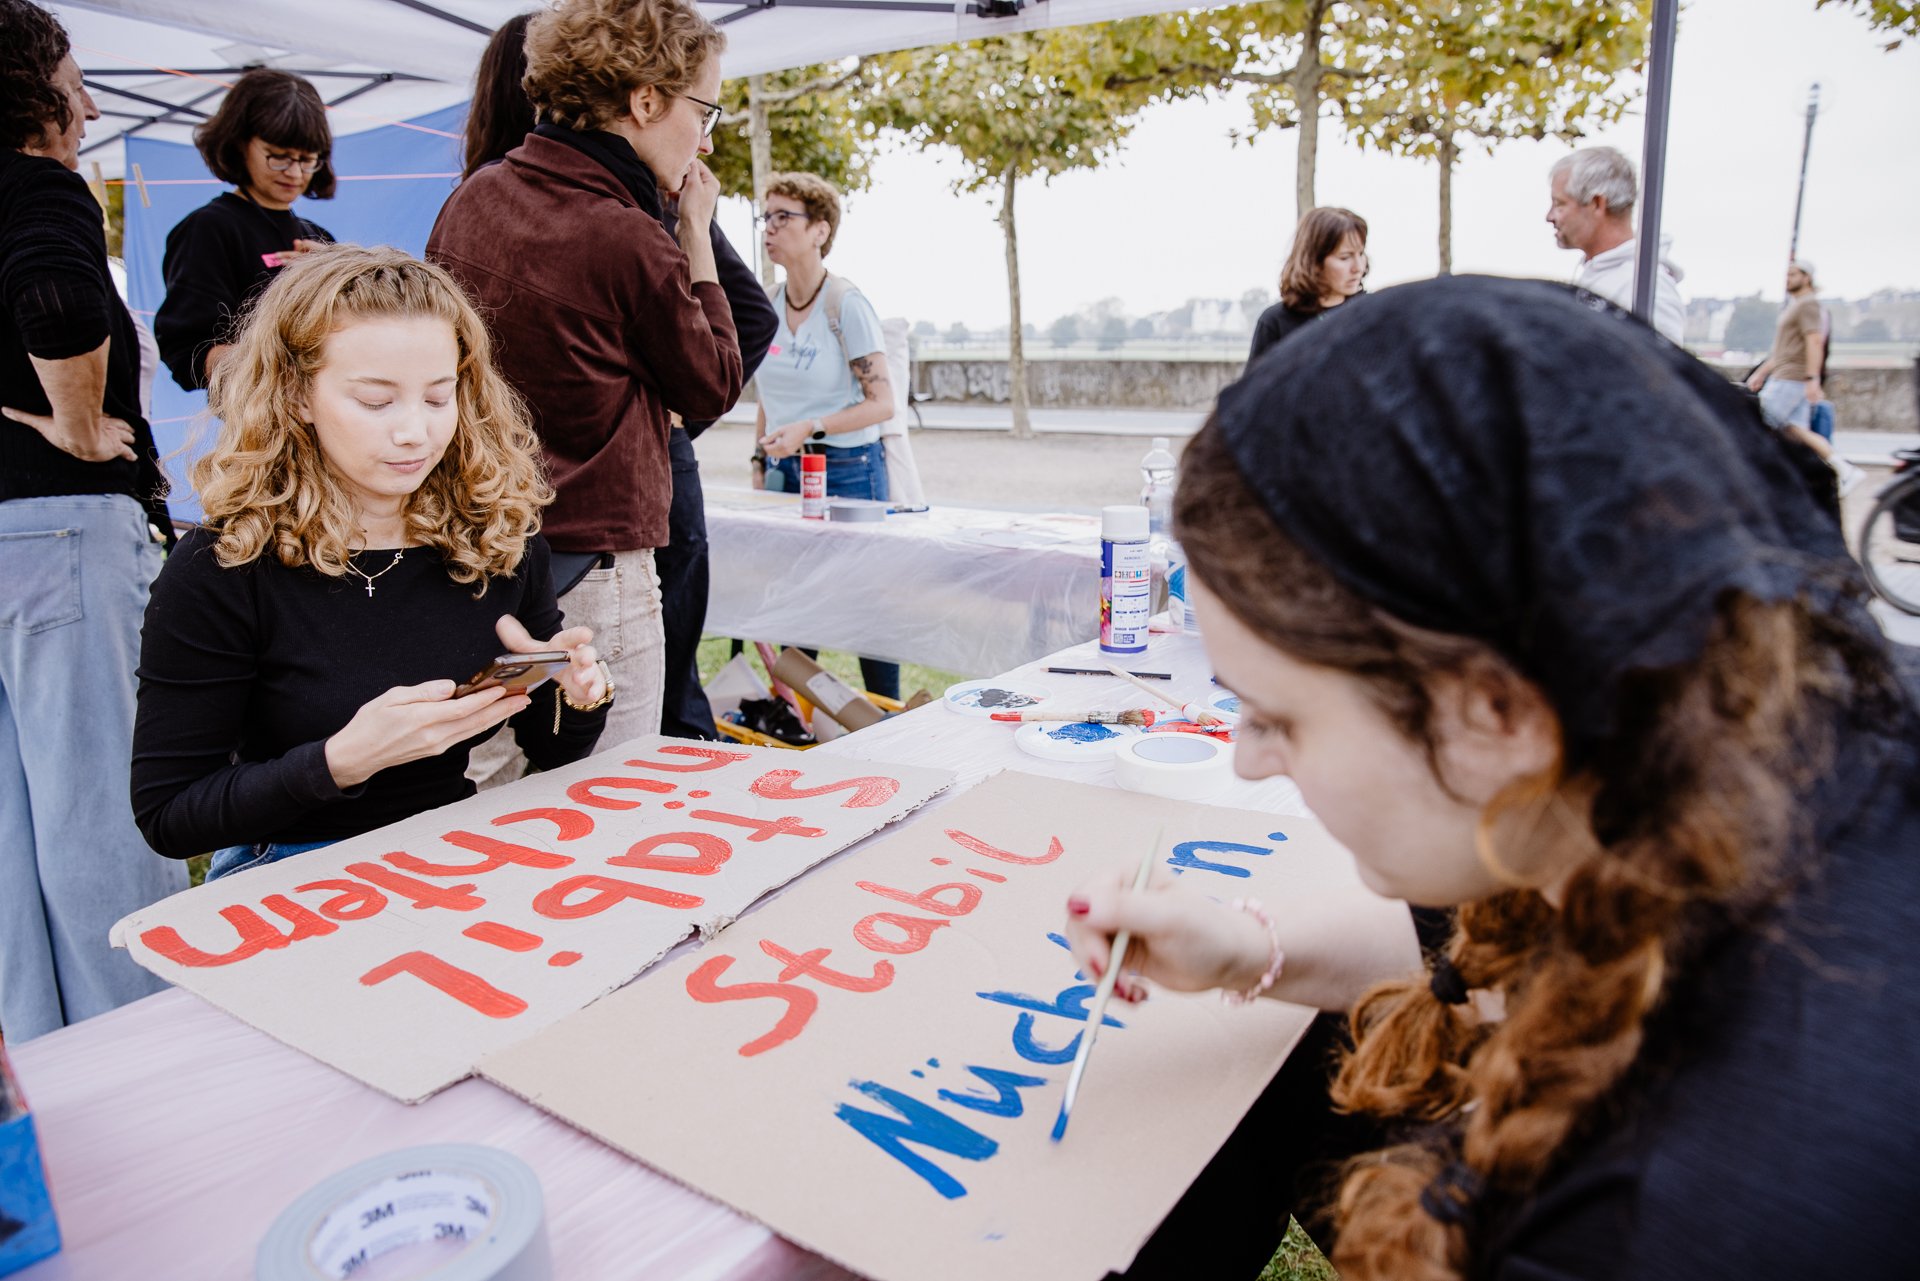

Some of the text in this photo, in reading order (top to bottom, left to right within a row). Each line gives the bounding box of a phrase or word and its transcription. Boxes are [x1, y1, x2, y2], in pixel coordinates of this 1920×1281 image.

[140, 744, 752, 968] nüchtern
[685, 829, 1064, 1057] Stabil
[835, 831, 1288, 1201] Nüchn.
[360, 1202, 395, 1230] 3M
[434, 1222, 466, 1241] 3M
